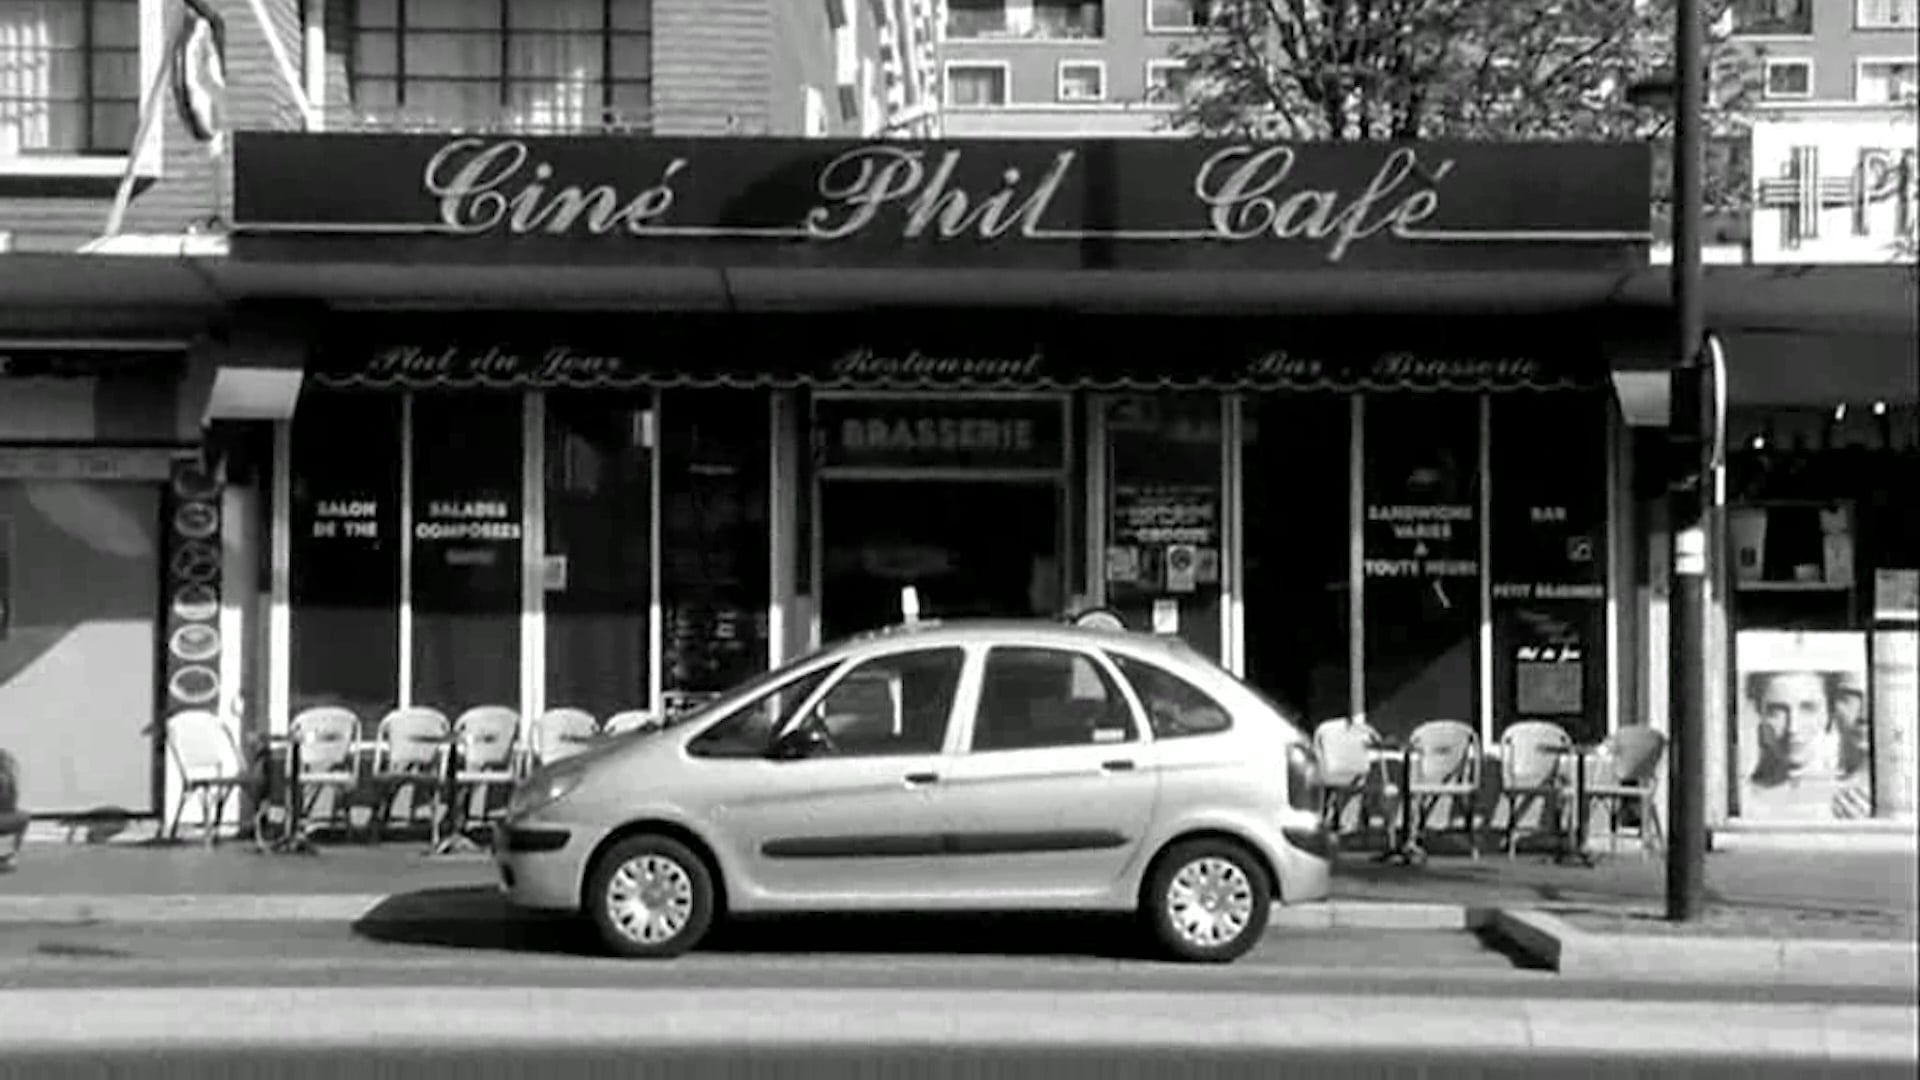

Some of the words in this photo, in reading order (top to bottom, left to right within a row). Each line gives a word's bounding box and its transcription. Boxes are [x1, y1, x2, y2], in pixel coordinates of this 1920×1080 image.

[424, 138, 688, 234] Ciné
[806, 145, 1075, 239] Phil
[1196, 146, 1455, 261] Café
[842, 417, 1035, 448] BRASSERIE
[316, 501, 377, 517] SALON
[429, 502, 507, 517] SALADES
[313, 521, 336, 537] DE
